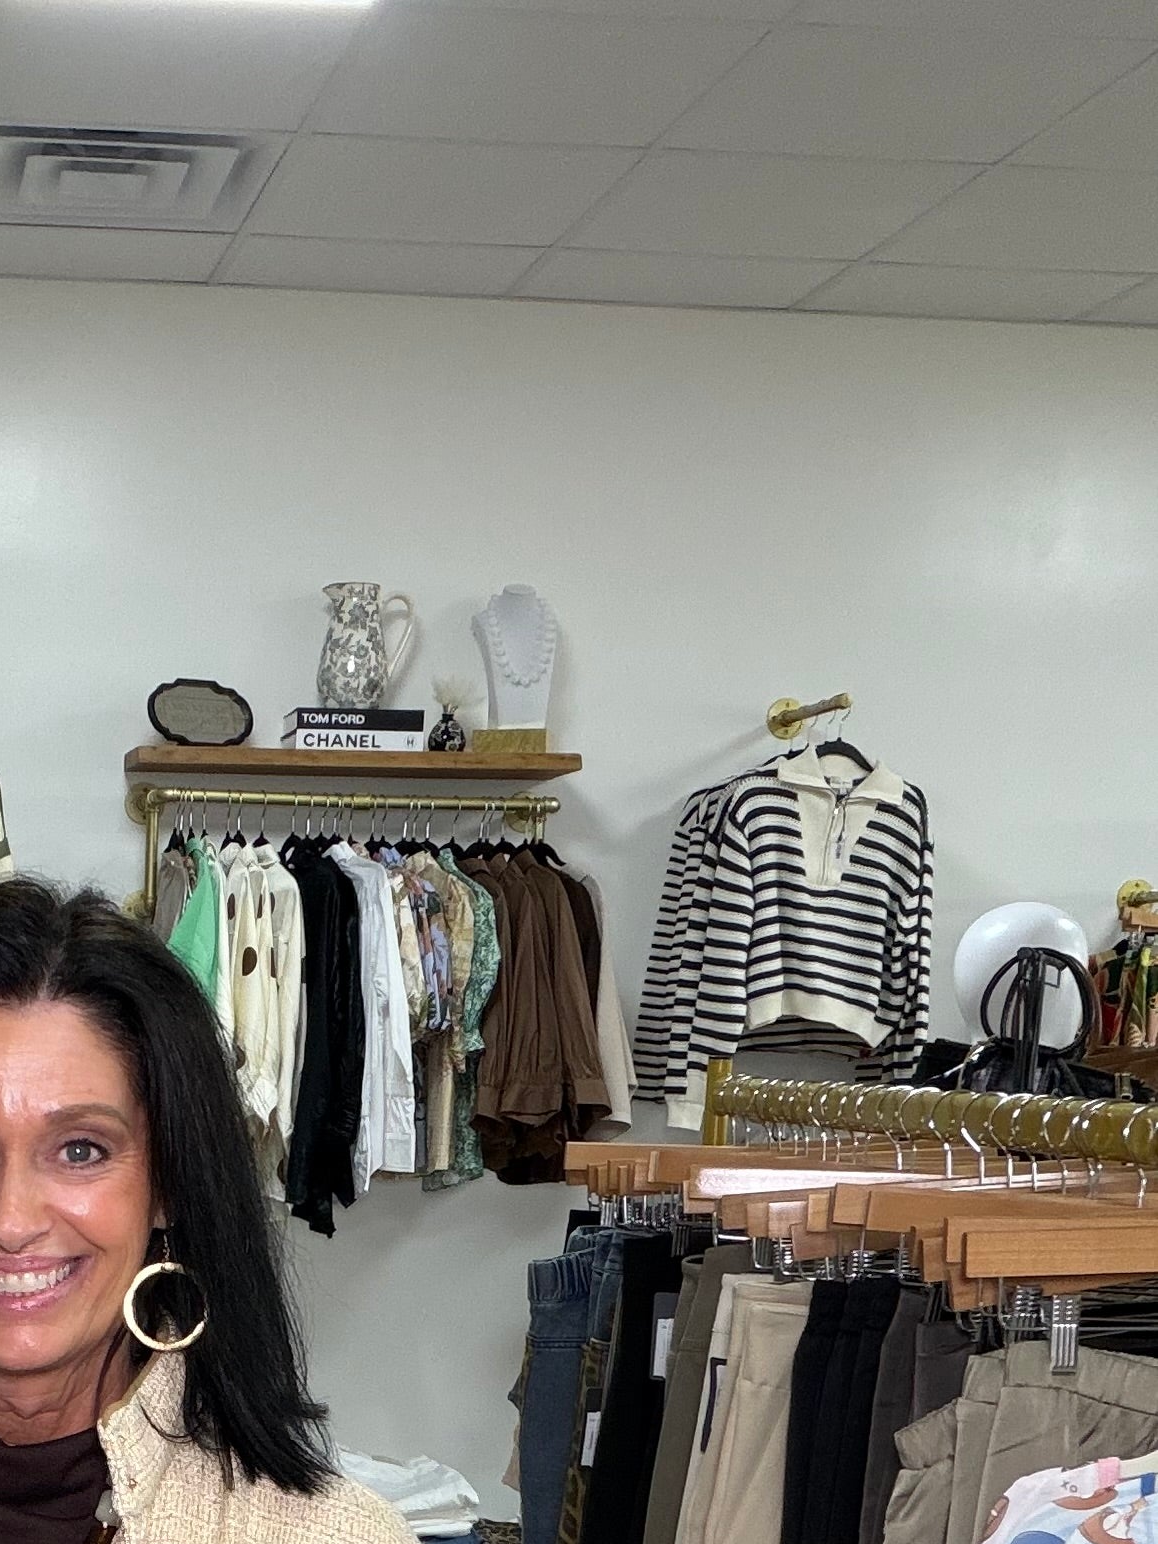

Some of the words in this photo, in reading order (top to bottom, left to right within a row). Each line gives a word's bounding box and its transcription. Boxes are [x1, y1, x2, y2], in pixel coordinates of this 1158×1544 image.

[302, 712, 329, 724] TOM
[332, 713, 365, 725] FORD
[303, 732, 381, 749] CHANEL
